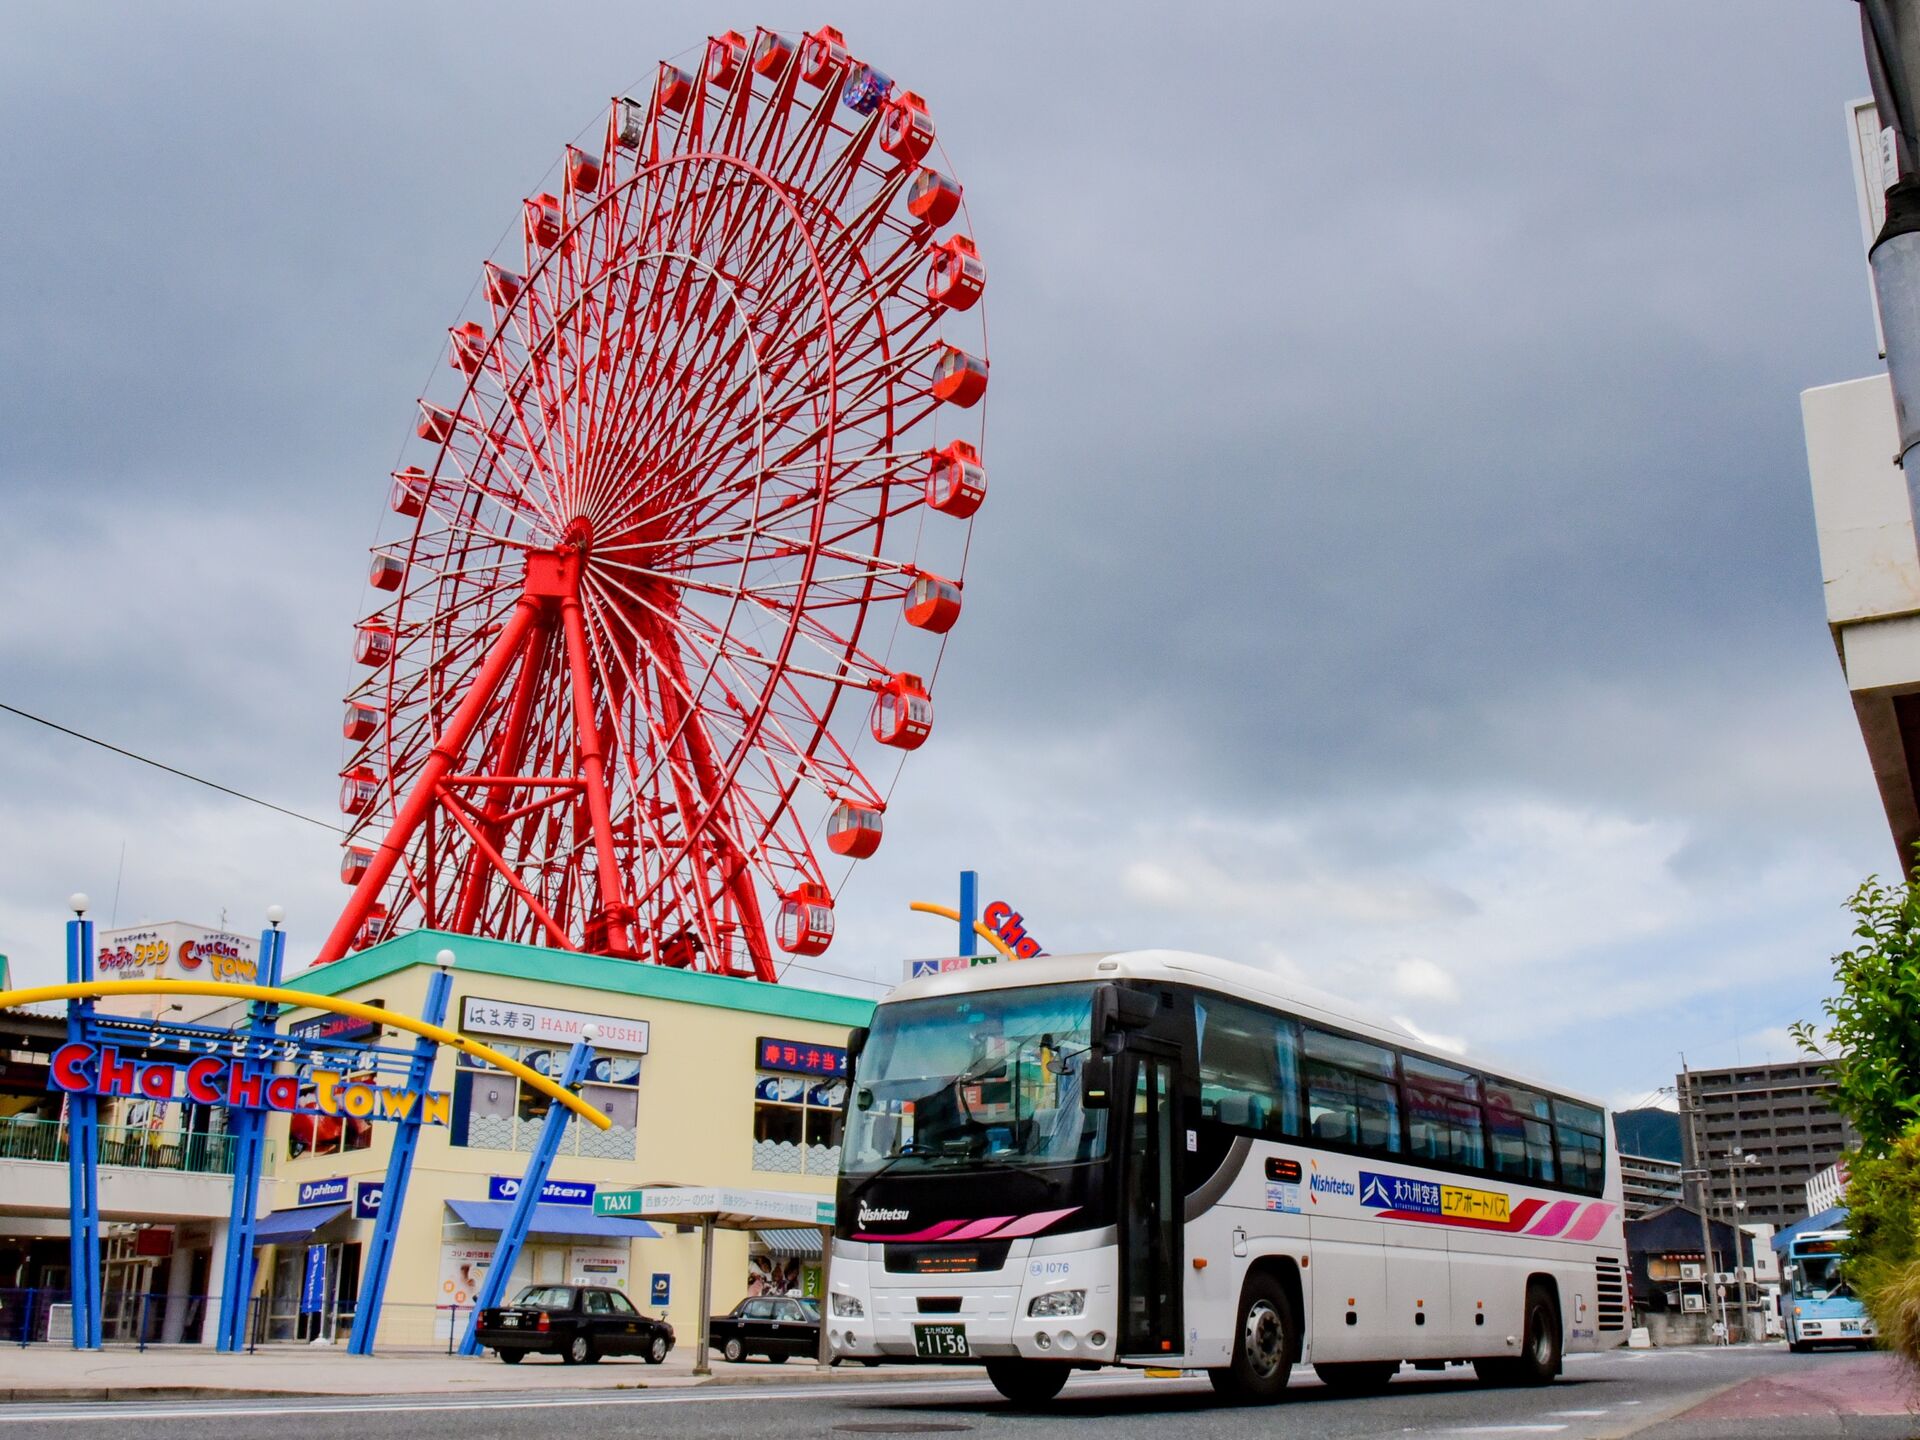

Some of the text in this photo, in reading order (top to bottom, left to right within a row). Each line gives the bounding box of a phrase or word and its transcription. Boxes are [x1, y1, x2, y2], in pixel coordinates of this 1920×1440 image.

[98, 940, 170, 972] チャチャタウン
[469, 1006, 536, 1032] はま寿司
[149, 1032, 378, 1071] ショッピングモール
[311, 1183, 344, 1200] phiten
[1310, 1172, 1355, 1197] Nishitetsu
[1394, 1180, 1439, 1206] 北九州空港
[602, 1196, 631, 1211] TAXI
[858, 1204, 909, 1223] Nishitetsu
[1444, 1190, 1507, 1218] エアポートバス
[1046, 1262, 1069, 1273] 1076
